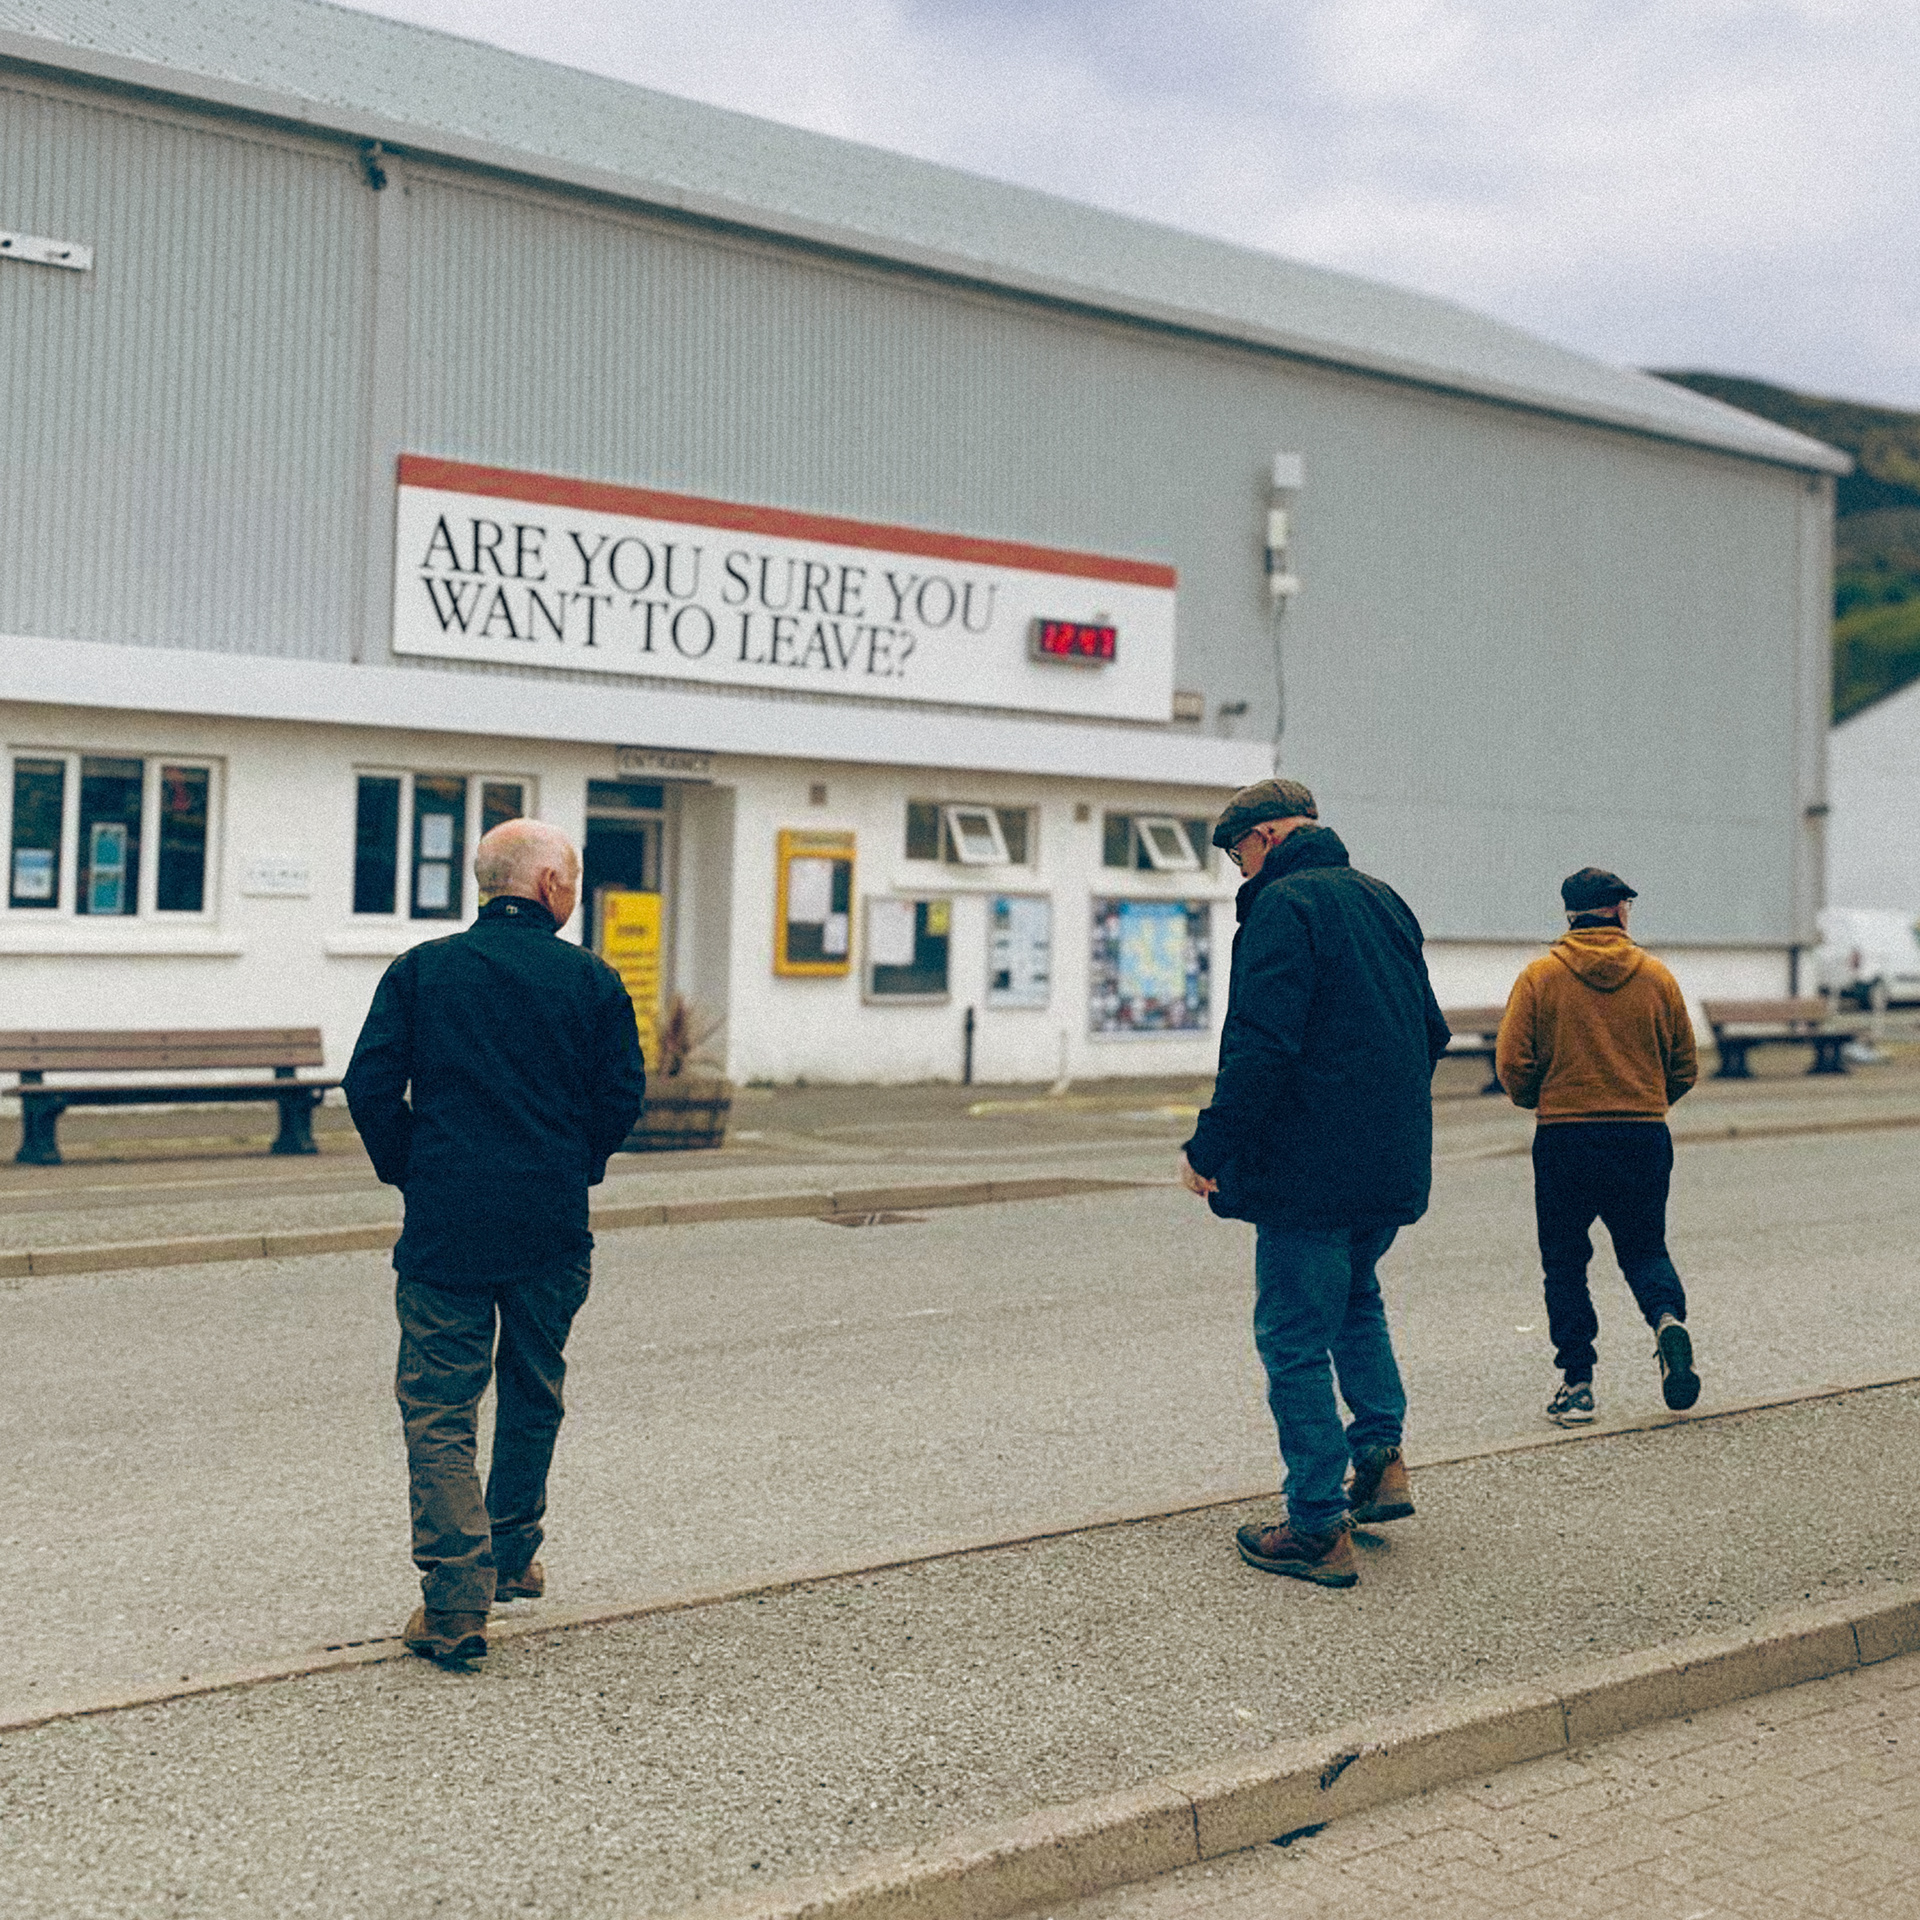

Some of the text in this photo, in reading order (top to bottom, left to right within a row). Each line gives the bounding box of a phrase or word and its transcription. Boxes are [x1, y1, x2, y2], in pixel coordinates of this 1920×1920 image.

[421, 514, 998, 633] ARE YOU SURE YOU
[421, 575, 917, 677] WANT TO LEAVE?
